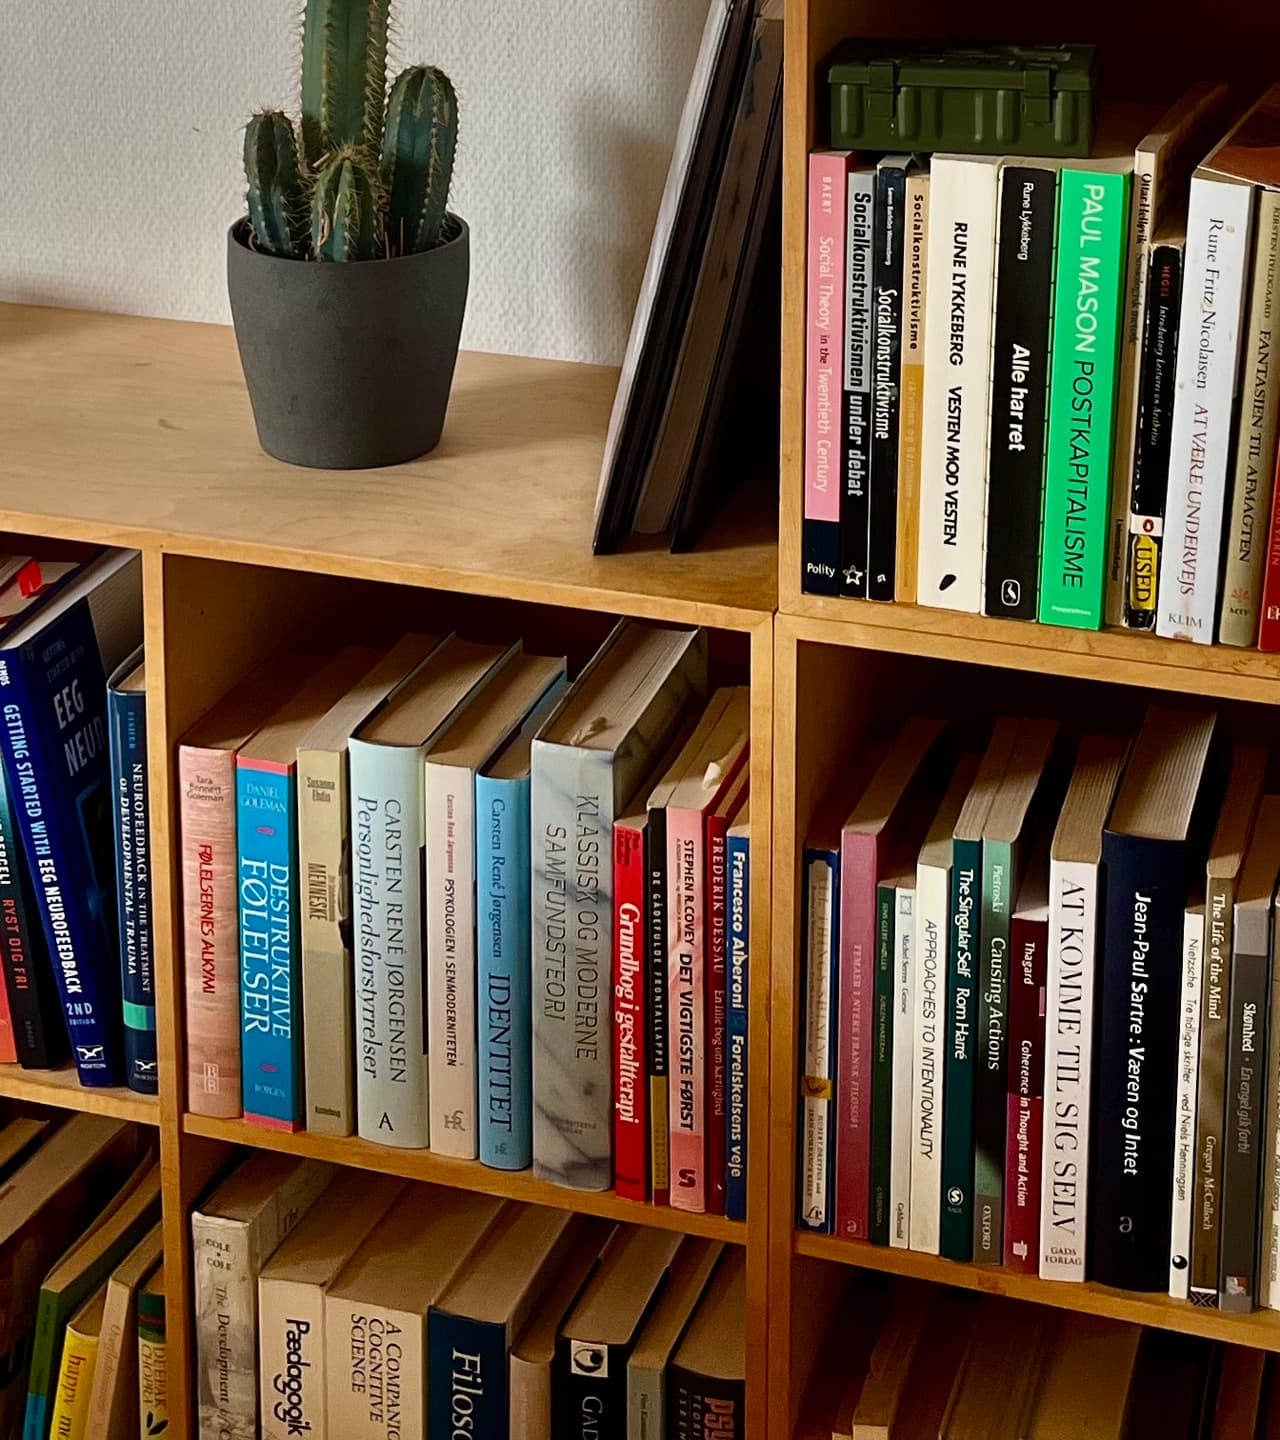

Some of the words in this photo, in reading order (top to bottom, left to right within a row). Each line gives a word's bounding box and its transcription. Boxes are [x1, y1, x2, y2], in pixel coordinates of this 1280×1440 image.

[952, 222, 968, 265] RUNE
[1079, 184, 1104, 250] PAUL
[1208, 219, 1224, 260] Rune
[844, 192, 871, 388] Socialkonstruktivismen
[950, 269, 965, 365] LYKKEBERG
[1074, 257, 1101, 352] MASON
[1204, 269, 1221, 307] Fritz
[1012, 345, 1031, 383] Alle
[1197, 313, 1219, 389] Nicolaisen
[848, 395, 865, 445] under
[946, 387, 962, 442] VESTEN
[1011, 389, 1027, 419] har
[945, 447, 960, 478] MOD
[1008, 424, 1026, 452] ret
[847, 451, 864, 497] debat
[1063, 361, 1096, 588] POSTKAPITALISME
[943, 482, 959, 545] VESTEN
[807, 563, 836, 578] Polity
[1135, 546, 1151, 603] USED
[39, 859, 58, 886] EEG
[199, 844, 215, 938] FØLELSERNES
[732, 851, 746, 933] Francesco
[1060, 878, 1085, 920] AT
[45, 890, 82, 994] NEUROFEEDBACK
[242, 858, 270, 1034] FØLELSER
[269, 864, 291, 1039] DESTRUKTIVE
[353, 797, 379, 1079] Personlighedsforstyrrelser
[617, 903, 641, 997] Grundbog
[1131, 892, 1151, 977] Jean-Paul
[201, 940, 215, 994] ALKYMI
[732, 936, 745, 1010] Alberoni
[1058, 932, 1084, 1037] KOMME
[488, 973, 513, 1132] IDENTITET
[615, 1009, 640, 1123] gestaltterapi
[1057, 1046, 1081, 1093] TIL
[1127, 1048, 1147, 1100] Væren
[730, 1035, 745, 1140] Forelskelsens
[1122, 1105, 1139, 1128] og
[1053, 1102, 1078, 1151] SIG
[1123, 1133, 1138, 1176] Intet
[729, 1143, 742, 1178] veje
[1051, 1164, 1078, 1237] SELV
[273, 1318, 310, 1438] Pædagogik
[351, 1313, 367, 1394] SCIENCE
